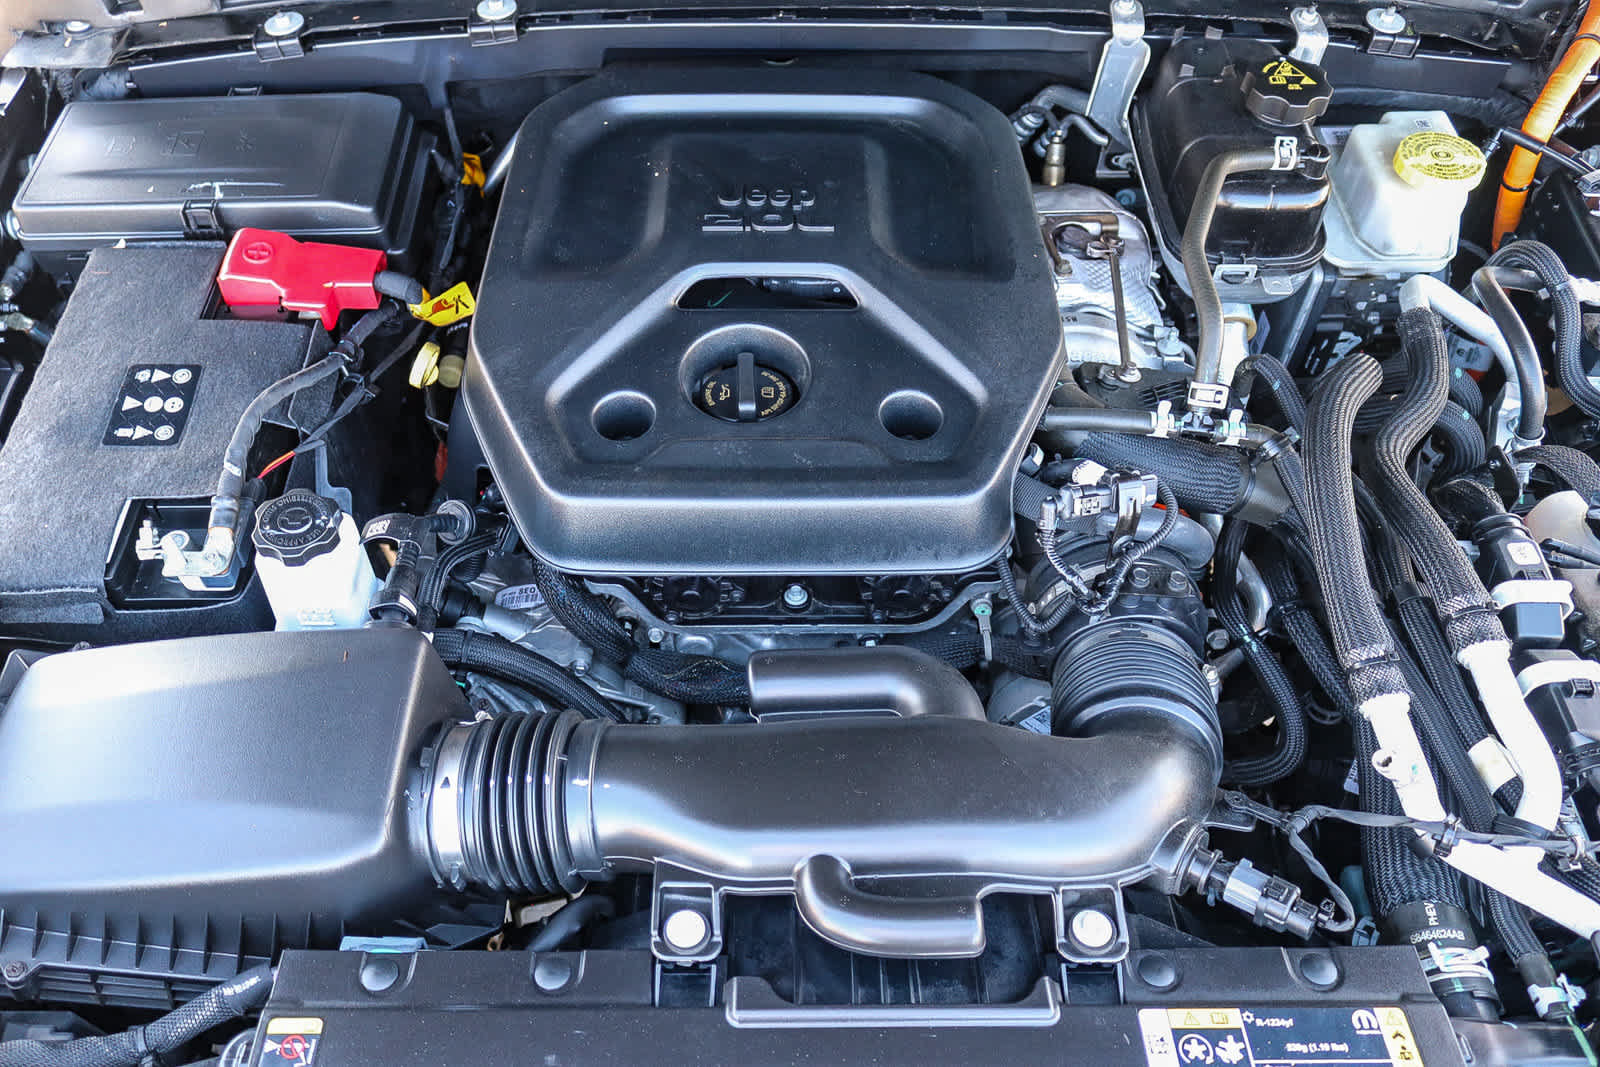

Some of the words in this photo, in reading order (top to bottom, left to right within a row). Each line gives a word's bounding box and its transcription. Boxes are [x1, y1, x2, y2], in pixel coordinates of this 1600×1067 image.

[717, 187, 815, 211] Jeep
[701, 213, 835, 232] 2.0L
[1423, 902, 1440, 926] PHEV
